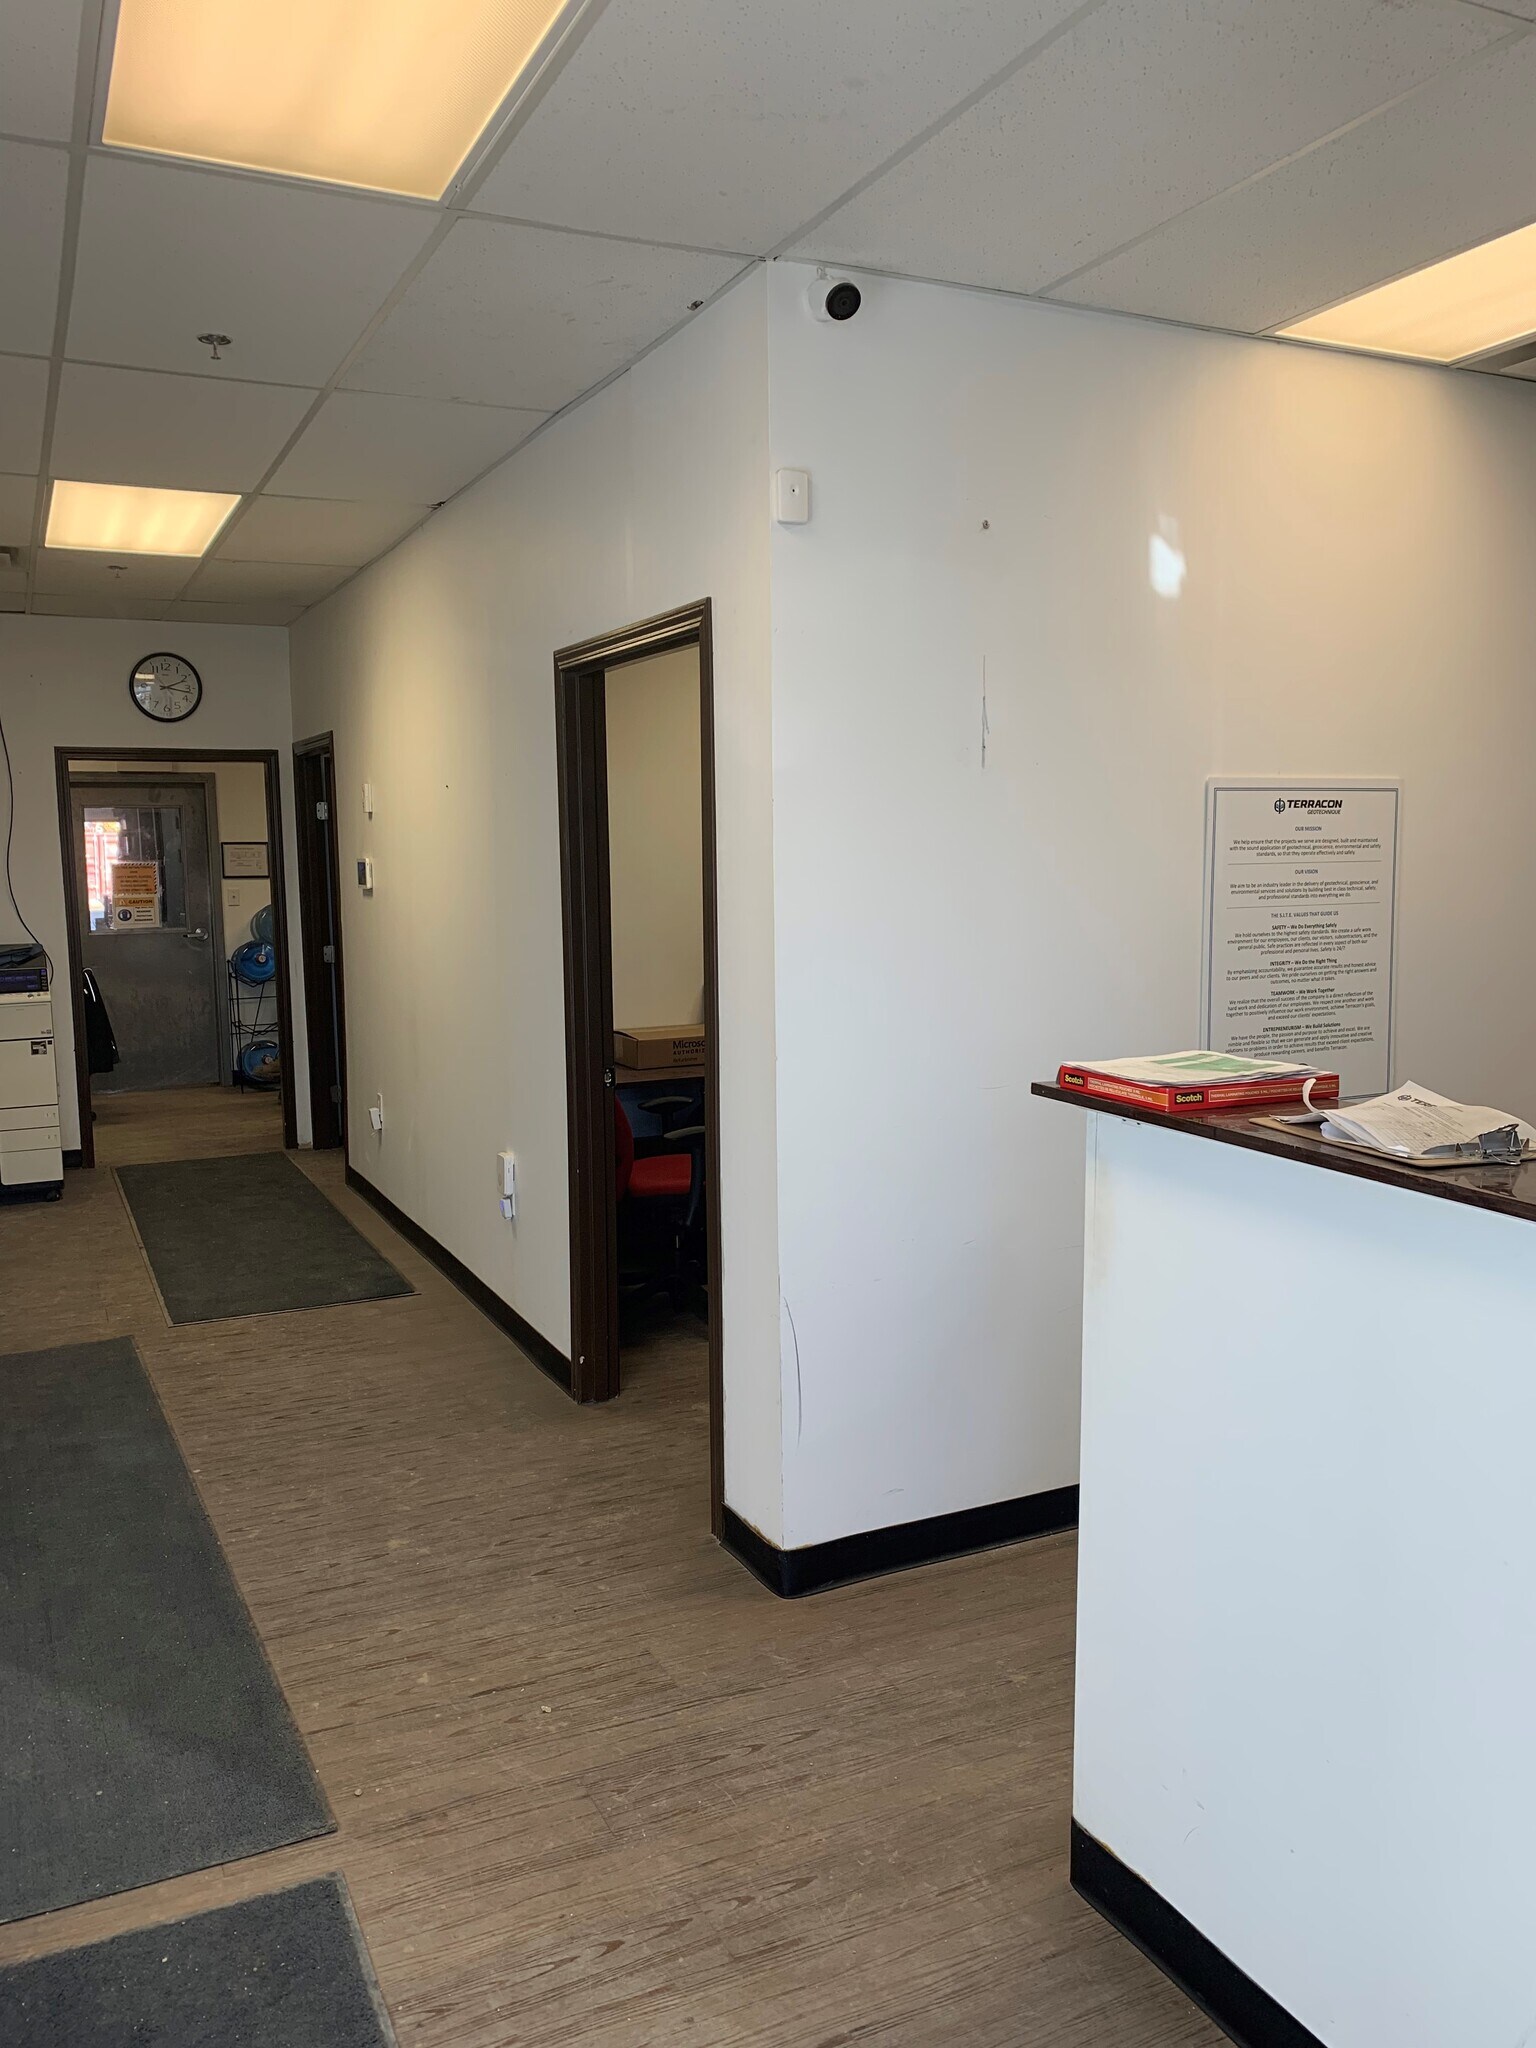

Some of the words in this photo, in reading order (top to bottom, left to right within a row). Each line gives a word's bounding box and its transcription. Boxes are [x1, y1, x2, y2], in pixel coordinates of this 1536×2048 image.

[161, 663, 171, 671] 12
[174, 702, 181, 710] 5
[1287, 800, 1343, 808] TERRACON
[672, 1040, 705, 1049] Microso
[1064, 1074, 1083, 1085] Scotch
[1176, 1094, 1202, 1103] Scotch
